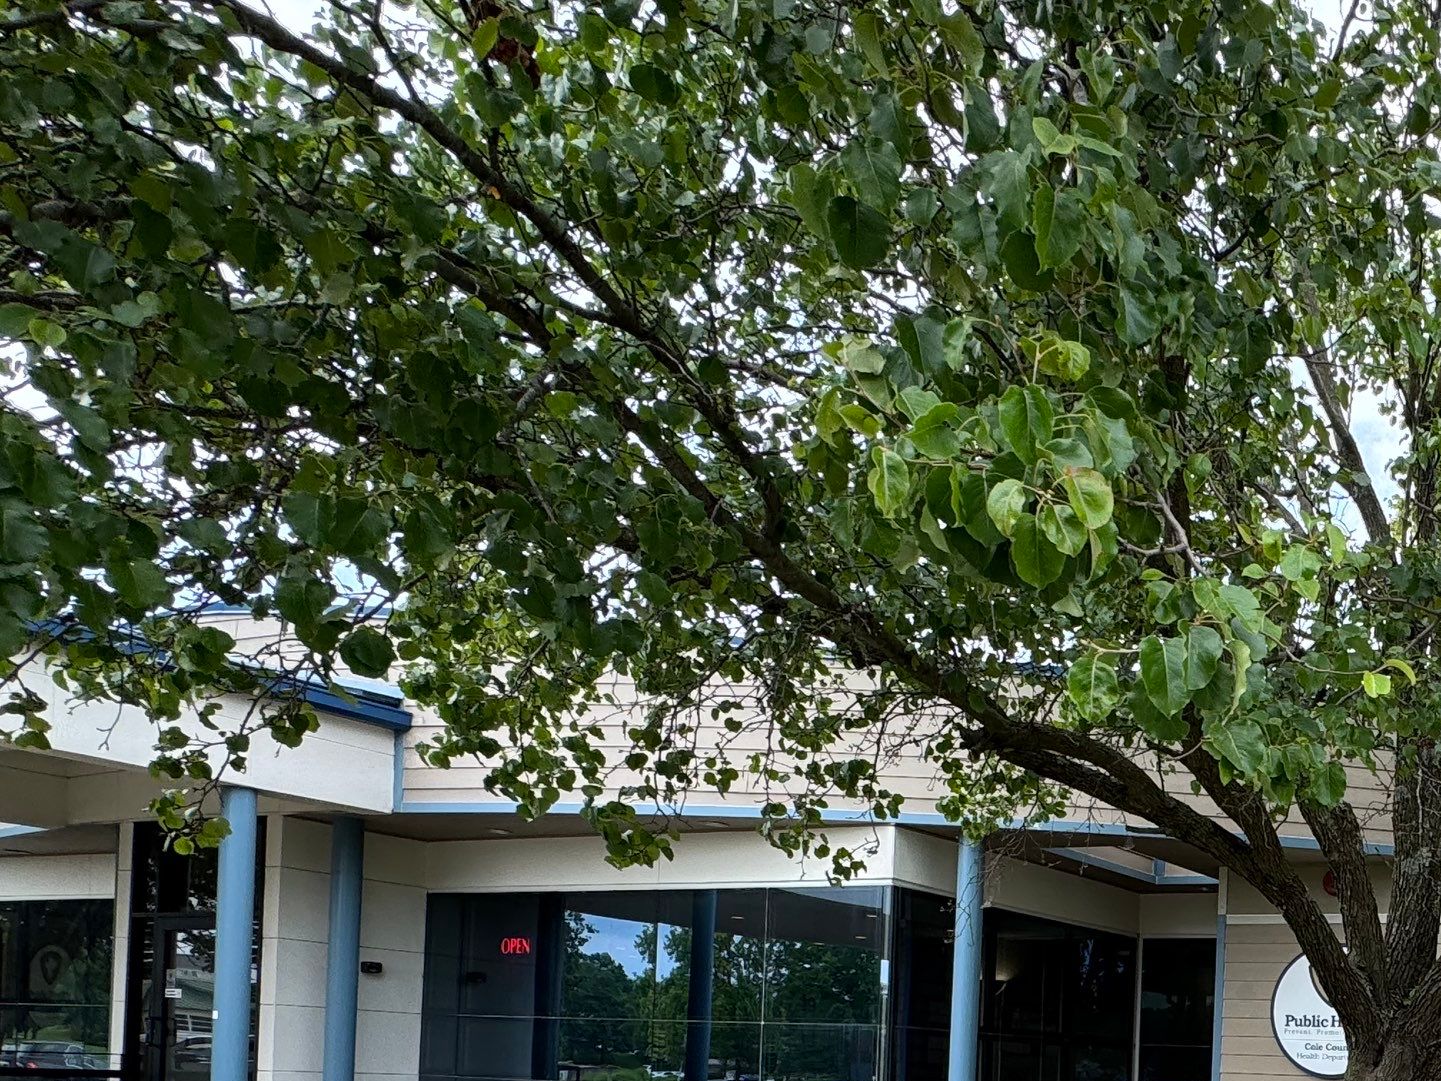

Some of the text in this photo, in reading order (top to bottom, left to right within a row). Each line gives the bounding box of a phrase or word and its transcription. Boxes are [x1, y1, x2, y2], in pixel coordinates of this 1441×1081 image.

[501, 938, 530, 954] OPEN
[1284, 1014, 1329, 1028] Public
[1304, 1042, 1323, 1051] Cole
